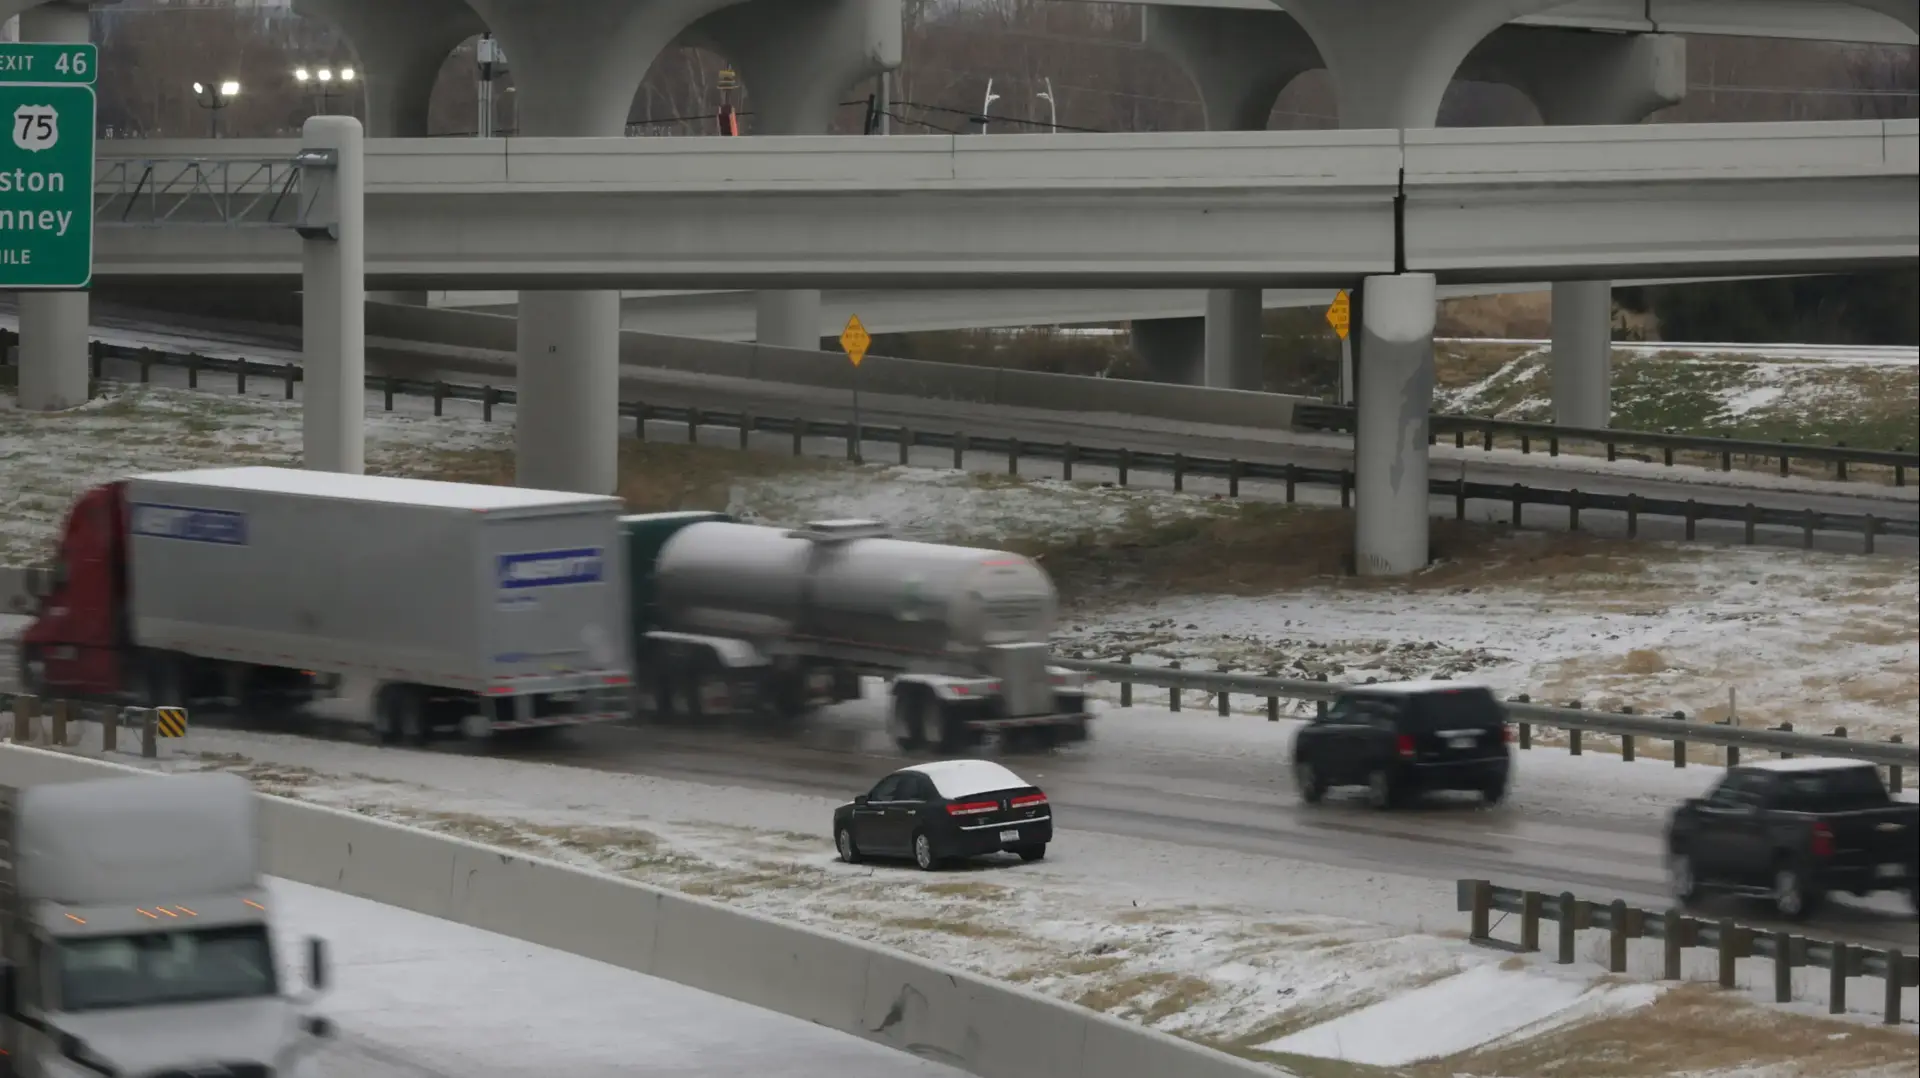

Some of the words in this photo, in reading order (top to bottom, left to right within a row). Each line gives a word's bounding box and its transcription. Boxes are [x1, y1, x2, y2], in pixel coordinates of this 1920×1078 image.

[54, 52, 87, 75] 46
[18, 114, 53, 141] 75
[0, 168, 64, 192] ston
[0, 210, 72, 236] nney
[0, 249, 31, 265] ILE
